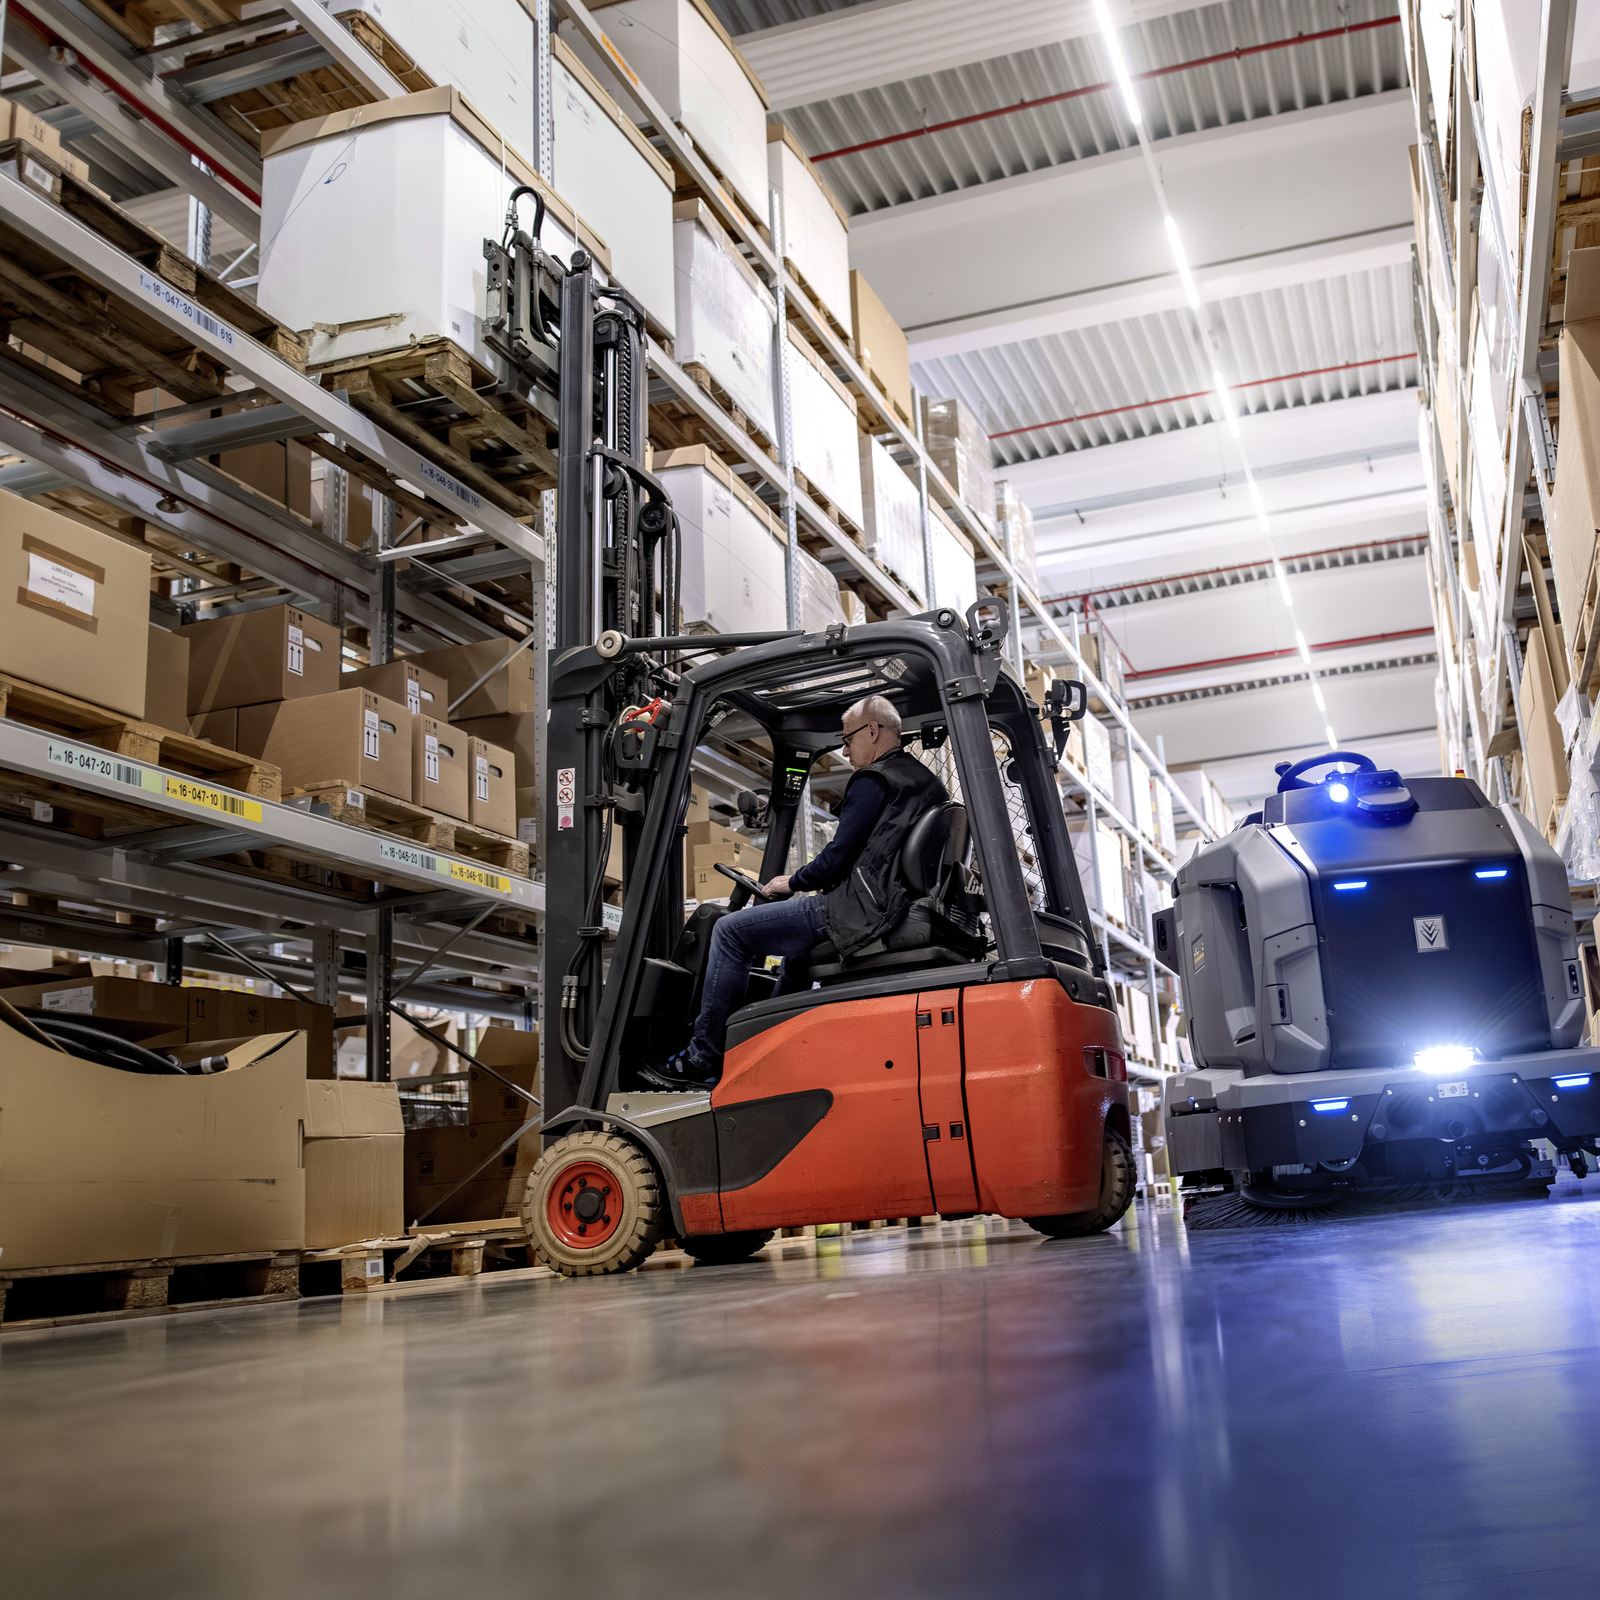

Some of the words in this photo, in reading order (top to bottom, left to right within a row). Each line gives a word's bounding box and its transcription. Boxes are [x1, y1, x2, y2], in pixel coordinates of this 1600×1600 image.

[153, 283, 192, 317] 16-047-30
[220, 328, 233, 344] 619
[64, 749, 112, 775] 16-047-20
[179, 783, 218, 806] 16-047-10
[389, 846, 418, 865] 16-046-20
[458, 867, 483, 883] 16-046-10
